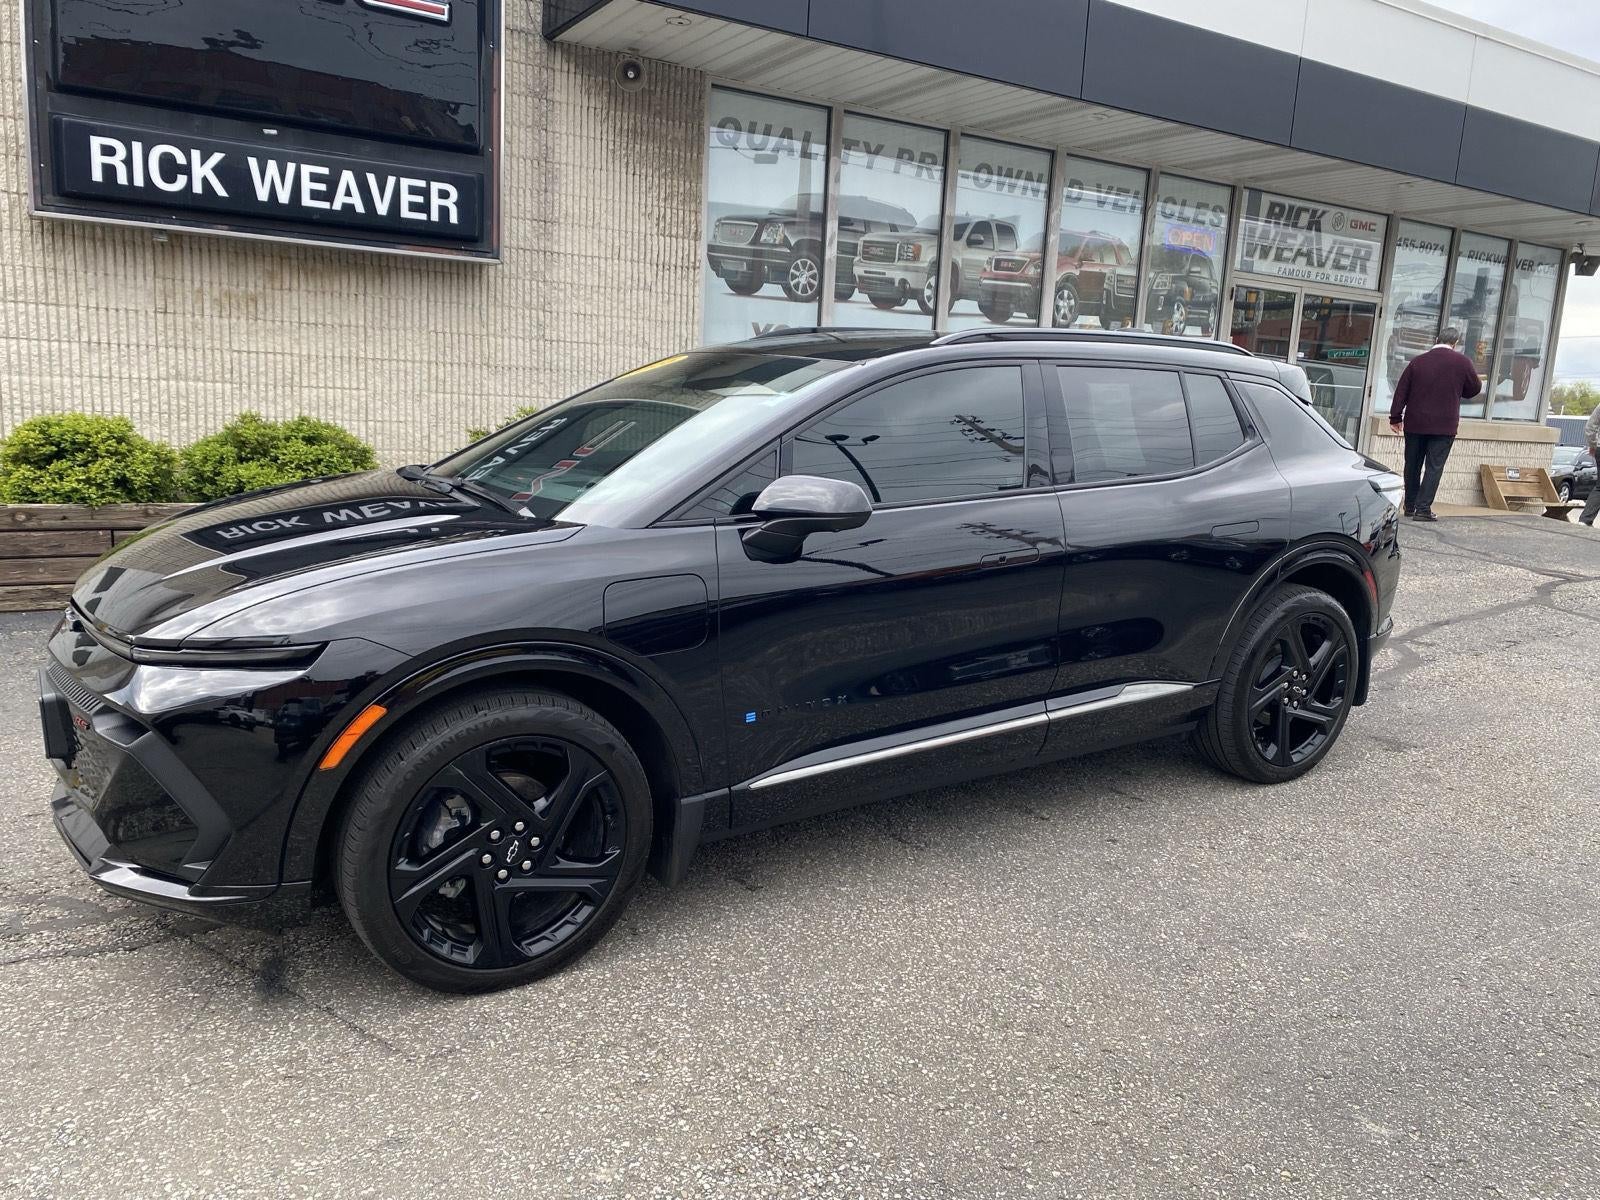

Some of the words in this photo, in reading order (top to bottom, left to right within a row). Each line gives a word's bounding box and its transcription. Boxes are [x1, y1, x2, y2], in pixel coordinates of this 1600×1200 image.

[89, 134, 228, 198] RICK
[247, 156, 458, 225] WEAVER
[715, 116, 885, 170] QUALTY
[1094, 181, 1225, 228] VEHCLES
[1264, 200, 1330, 233] RICK
[1350, 219, 1376, 232] GMC
[1168, 227, 1214, 252] OPEN
[1245, 226, 1372, 274] WEAVER
[1277, 266, 1312, 279] FAMOUS
[1315, 271, 1330, 281] FOR
[1334, 274, 1368, 285] SERVICE
